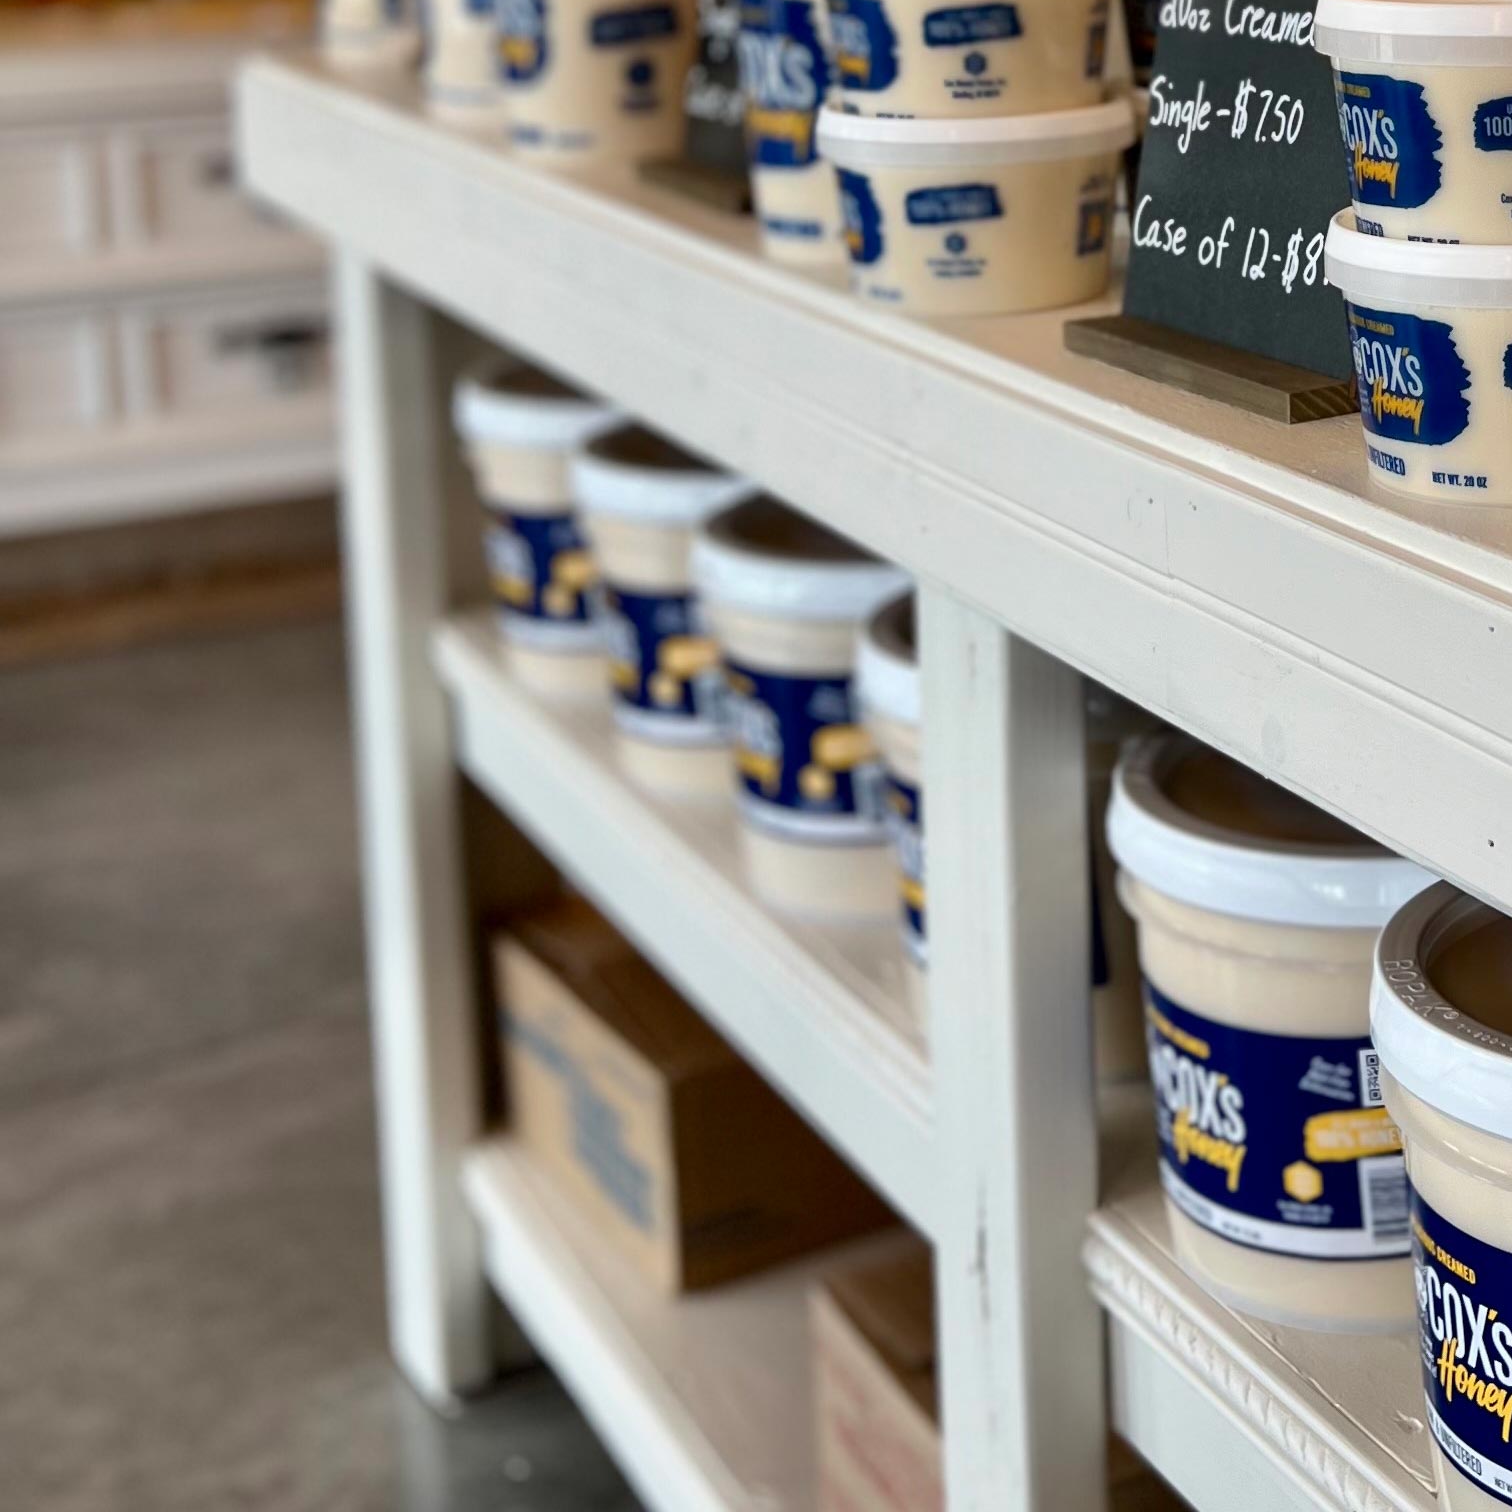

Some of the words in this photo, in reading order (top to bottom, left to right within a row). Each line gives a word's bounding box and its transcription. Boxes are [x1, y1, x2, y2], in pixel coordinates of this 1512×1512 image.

[1340, 103, 1399, 159] COX'S
[1133, 194, 1187, 256] Case
[1198, 216, 1235, 268] of
[1360, 337, 1425, 397] COX'S
[1371, 377, 1425, 437] Honey
[1432, 471, 1447, 484] NET
[1436, 1245, 1476, 1285] CREAMED
[1493, 1476, 1506, 1490] NET
